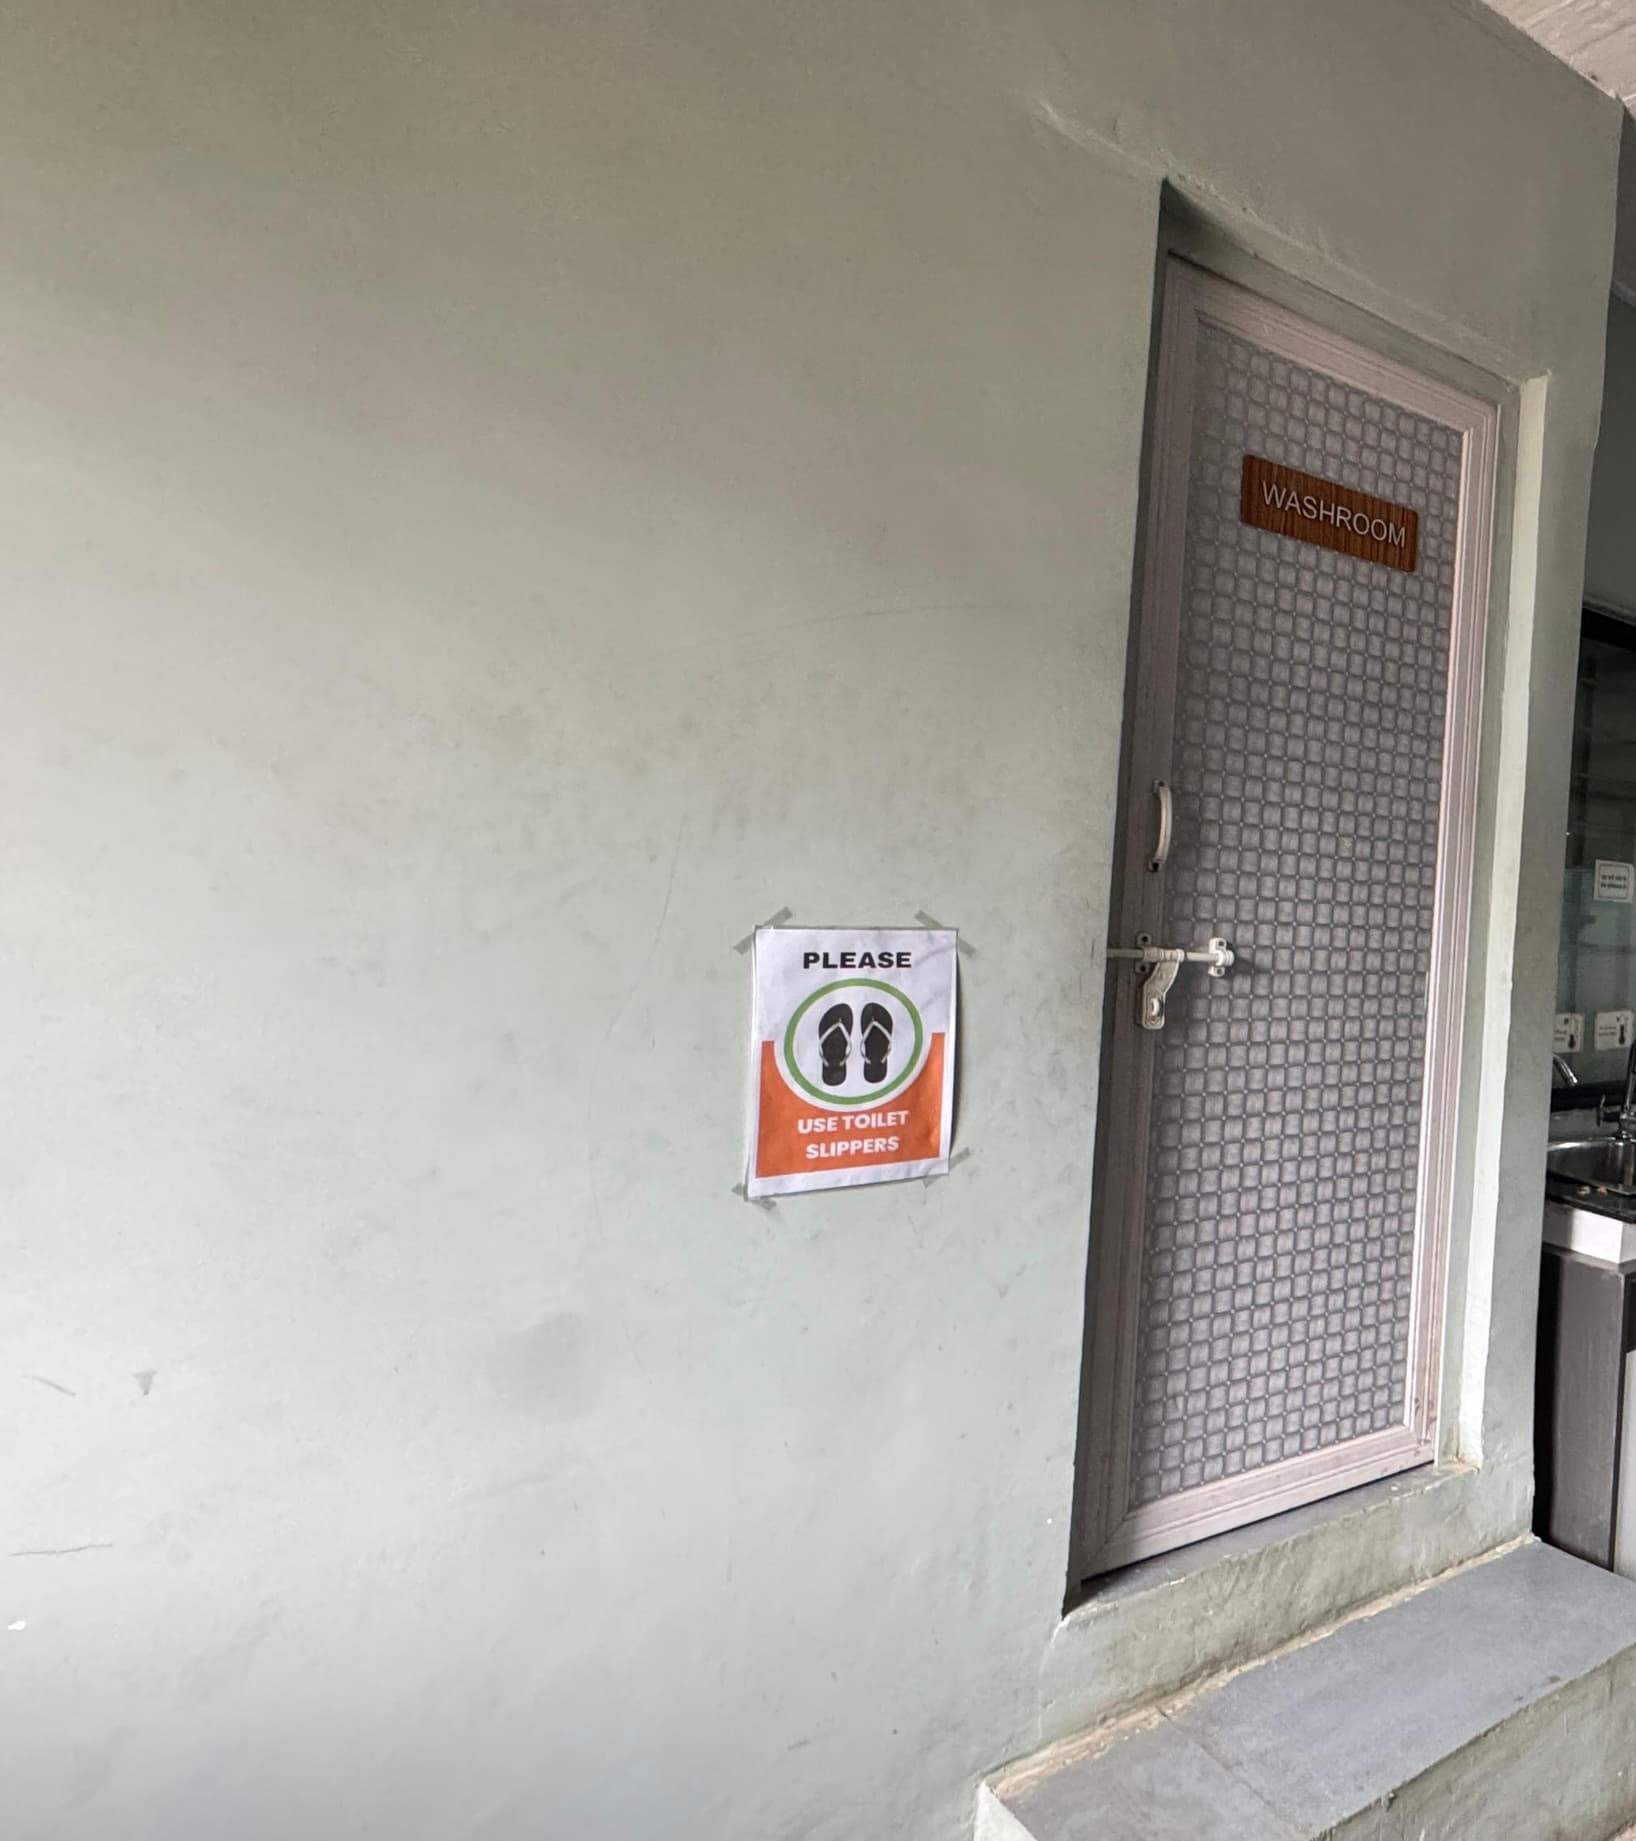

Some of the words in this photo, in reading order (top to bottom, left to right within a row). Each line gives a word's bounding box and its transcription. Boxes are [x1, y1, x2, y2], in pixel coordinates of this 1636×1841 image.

[1262, 480, 1406, 548] WASHROOM
[803, 952, 912, 969] PLEASE
[797, 1116, 838, 1134] USE
[842, 1110, 909, 1131] TOILET
[806, 1136, 900, 1159] SLIPPERS
